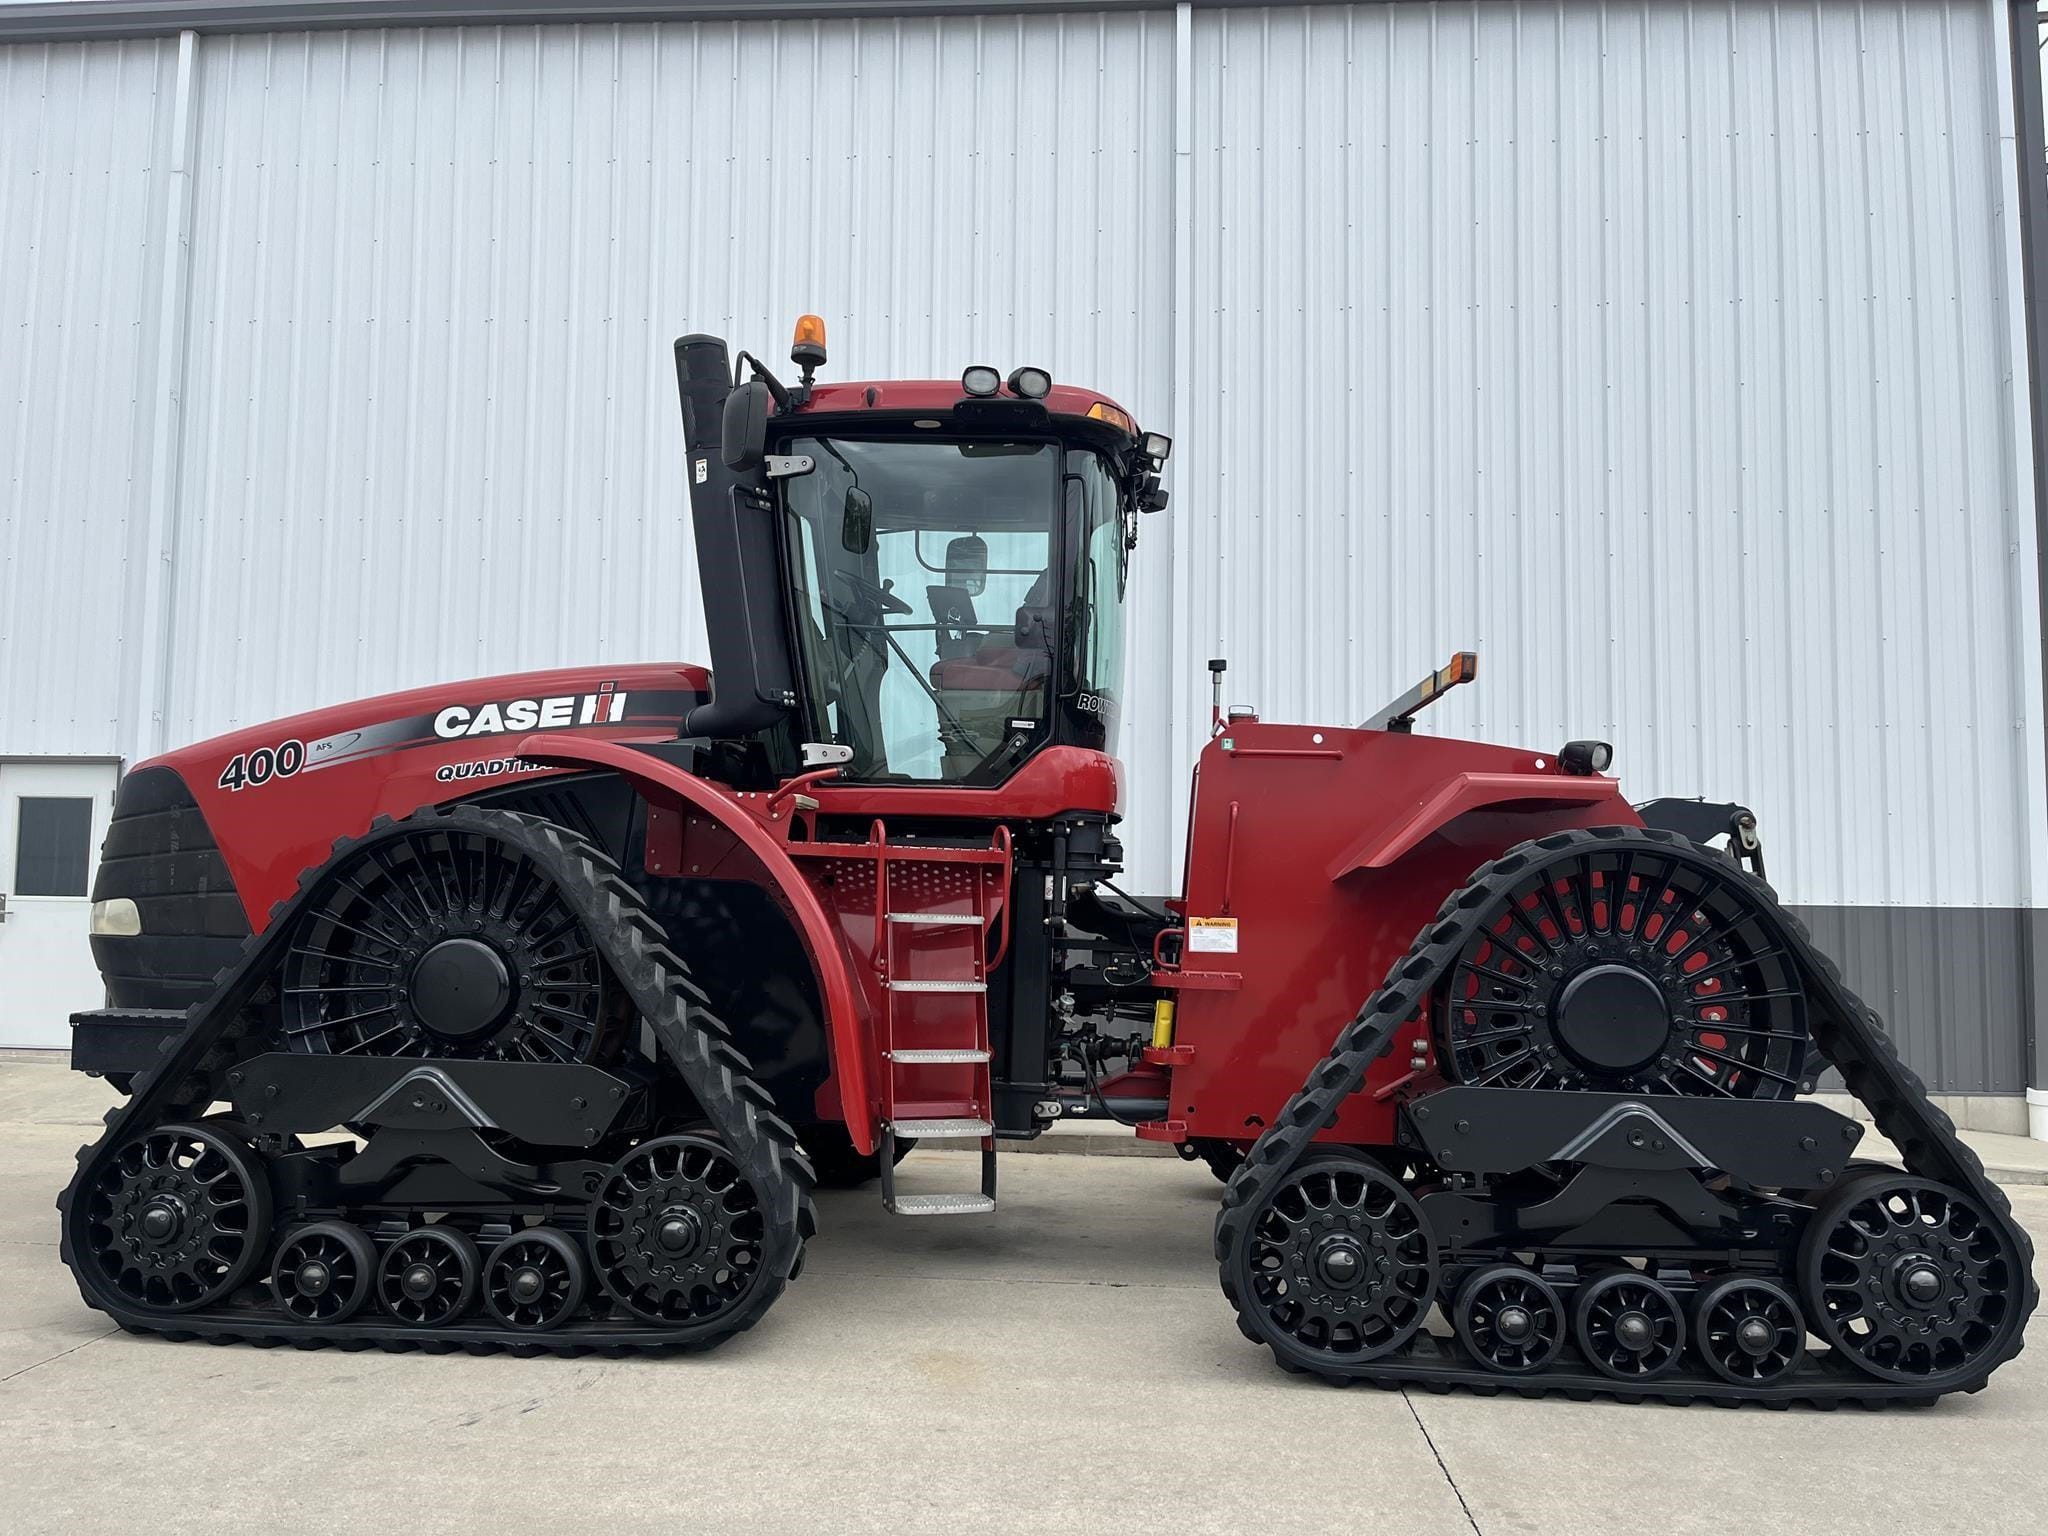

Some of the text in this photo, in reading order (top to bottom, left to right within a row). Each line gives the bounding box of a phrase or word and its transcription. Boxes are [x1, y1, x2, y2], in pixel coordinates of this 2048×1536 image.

[434, 696, 576, 739] CASE
[315, 742, 332, 752] AFS
[218, 739, 305, 792] 400
[435, 758, 553, 783] QUADTR
[1204, 920, 1232, 928] WARNING
